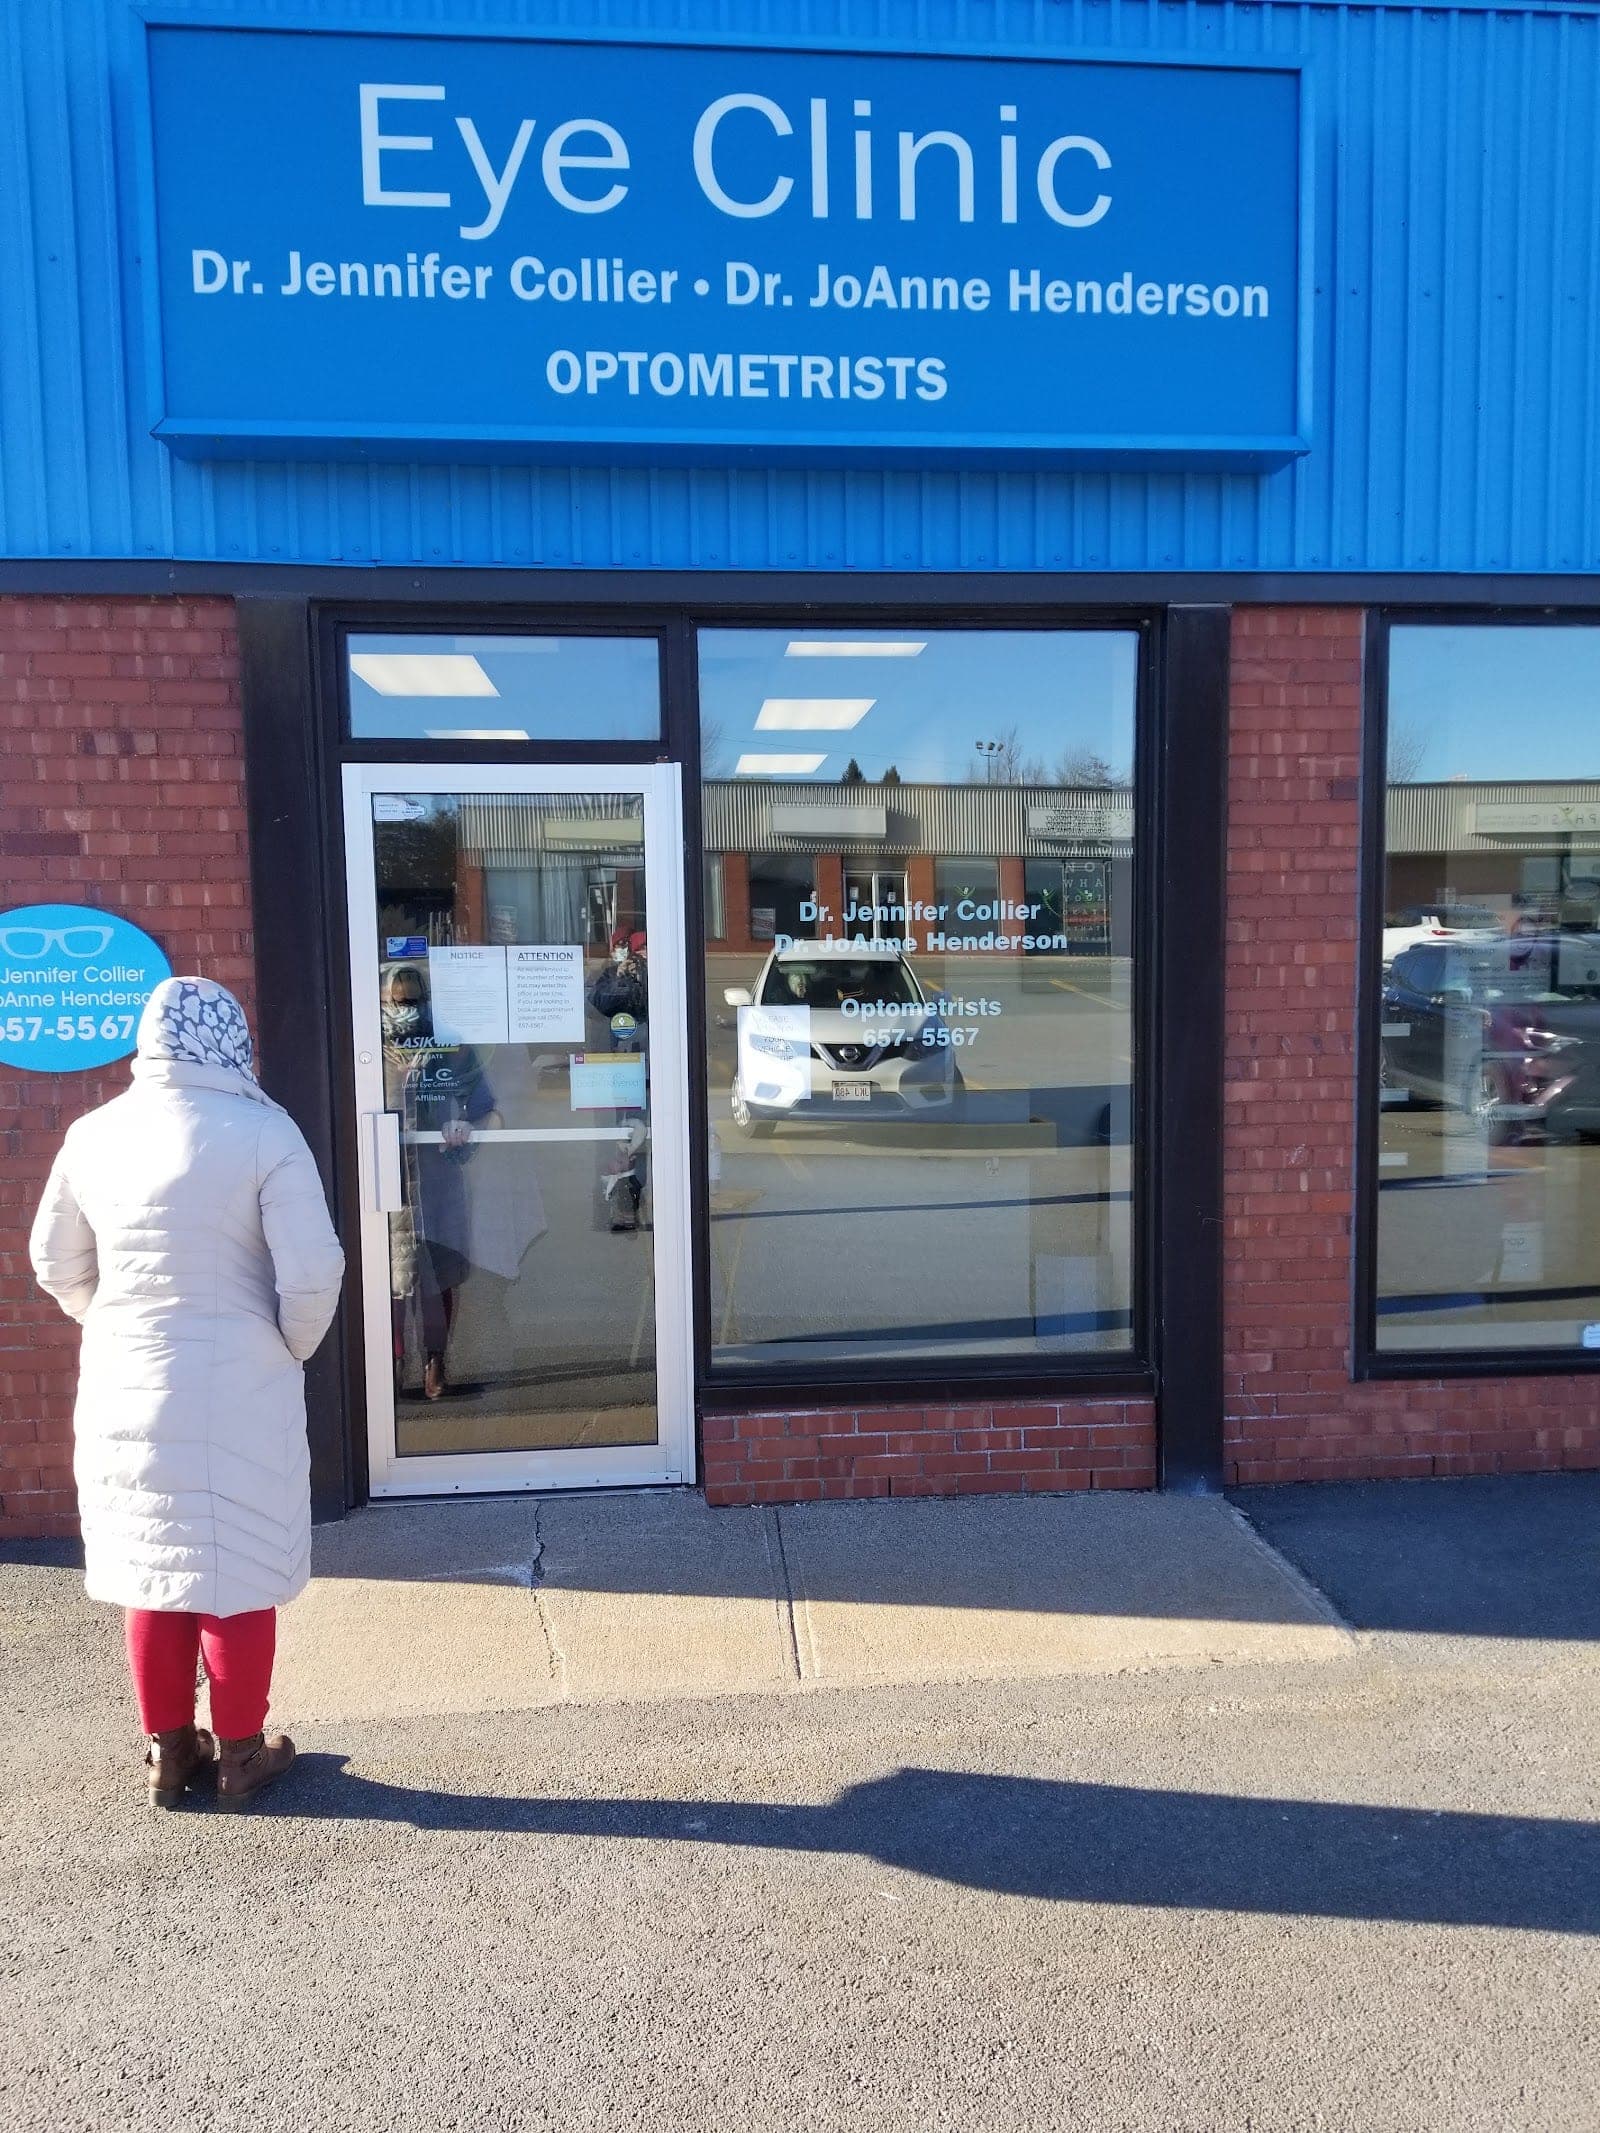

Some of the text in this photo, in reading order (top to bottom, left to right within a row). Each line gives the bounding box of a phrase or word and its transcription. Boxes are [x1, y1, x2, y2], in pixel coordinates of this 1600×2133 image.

[359, 83, 1112, 241] Eye Clinic
[191, 249, 1269, 318] Dr. Jennifer Collier Dr. JoAnne Henderson
[546, 349, 948, 401] OPTOMETRISTS
[800, 899, 1041, 922] Dr. Jennifer Collier
[774, 931, 1068, 953] Dr. JoAnne Henderson
[450, 951, 485, 960] NOTICE
[517, 952, 575, 961] ATTENTION
[0, 965, 145, 984] Jennifer Collier
[61, 989, 152, 1007] Henderso
[840, 996, 1002, 1023] Optometrists
[393, 1036, 434, 1048] LASIK
[862, 1027, 979, 1048] 657- 5567
[409, 1068, 453, 1081] TLC
